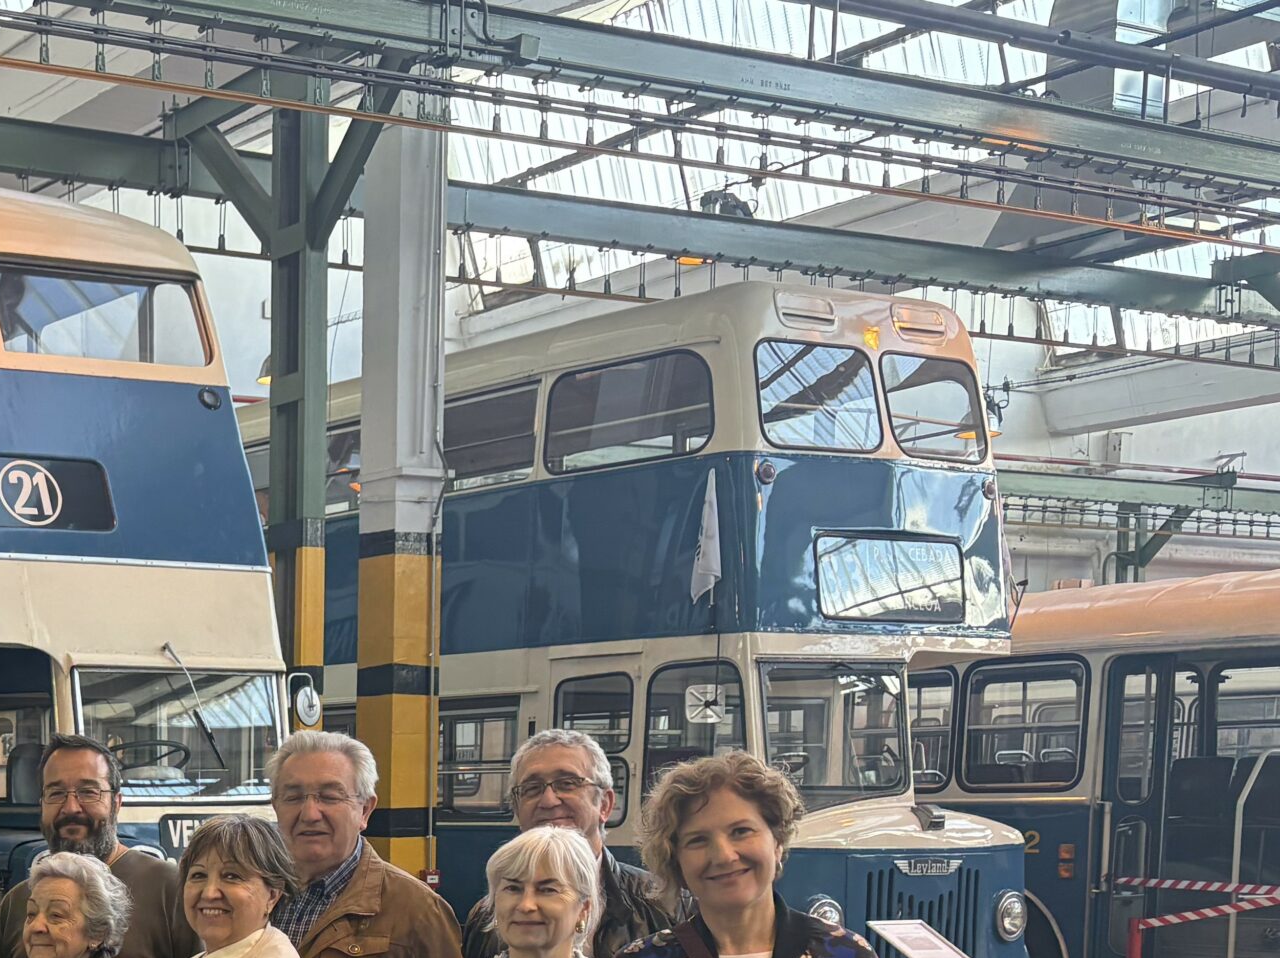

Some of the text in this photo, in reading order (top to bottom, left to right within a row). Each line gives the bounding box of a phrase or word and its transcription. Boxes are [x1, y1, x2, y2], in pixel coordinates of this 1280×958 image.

[7, 469, 54, 516] 21
[1023, 830, 1040, 854] 2
[910, 859, 948, 875] Leyland
